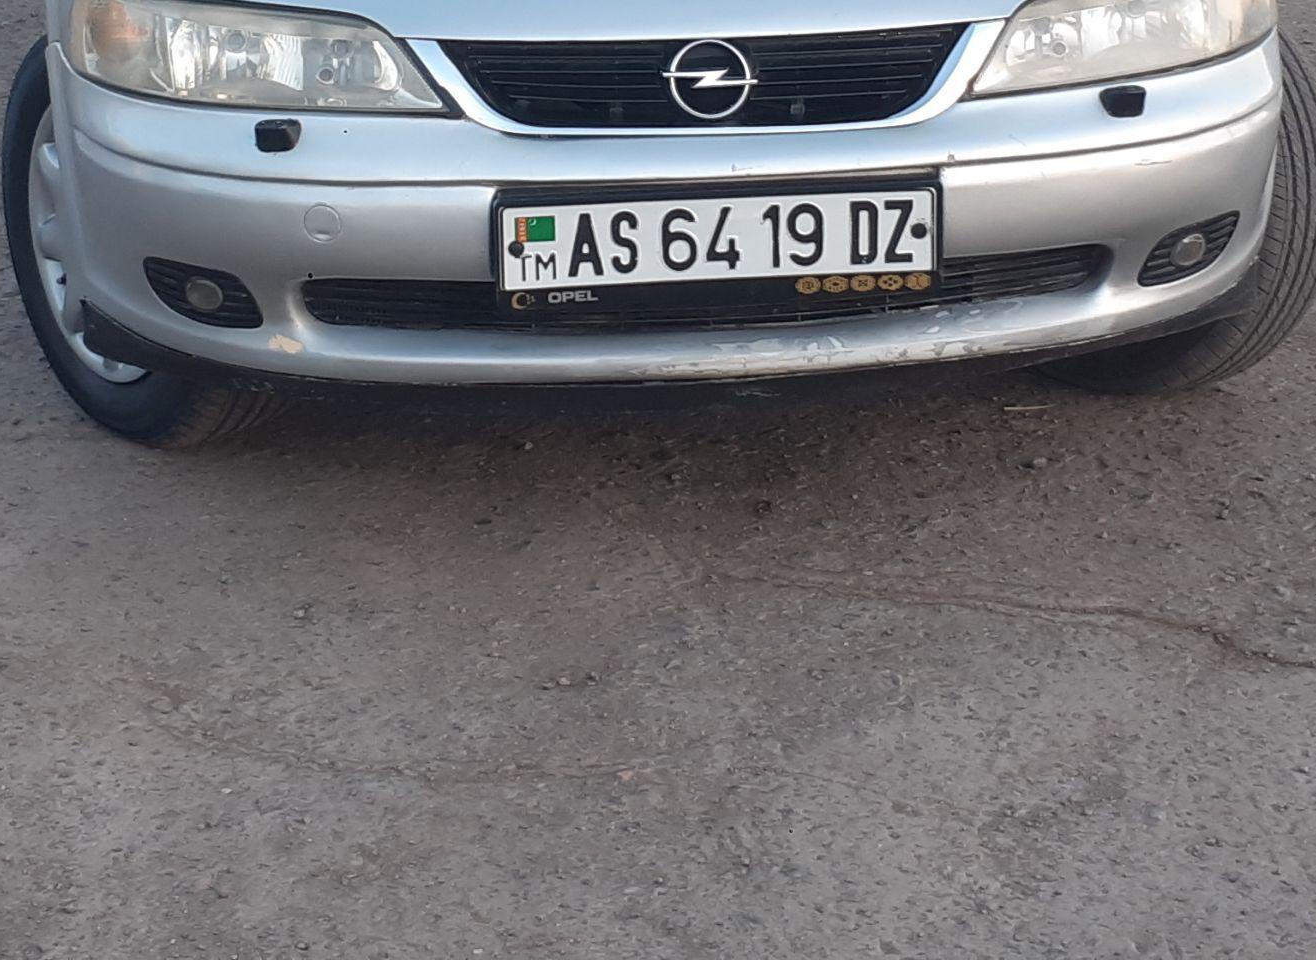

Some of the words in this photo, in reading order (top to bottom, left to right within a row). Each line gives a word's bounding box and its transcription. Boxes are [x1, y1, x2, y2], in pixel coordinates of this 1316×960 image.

[568, 211, 639, 277] AS
[661, 206, 741, 272] 64
[762, 202, 825, 268] 19
[849, 199, 915, 265] DZ
[518, 252, 557, 282] TM
[547, 289, 599, 304] OPEL
